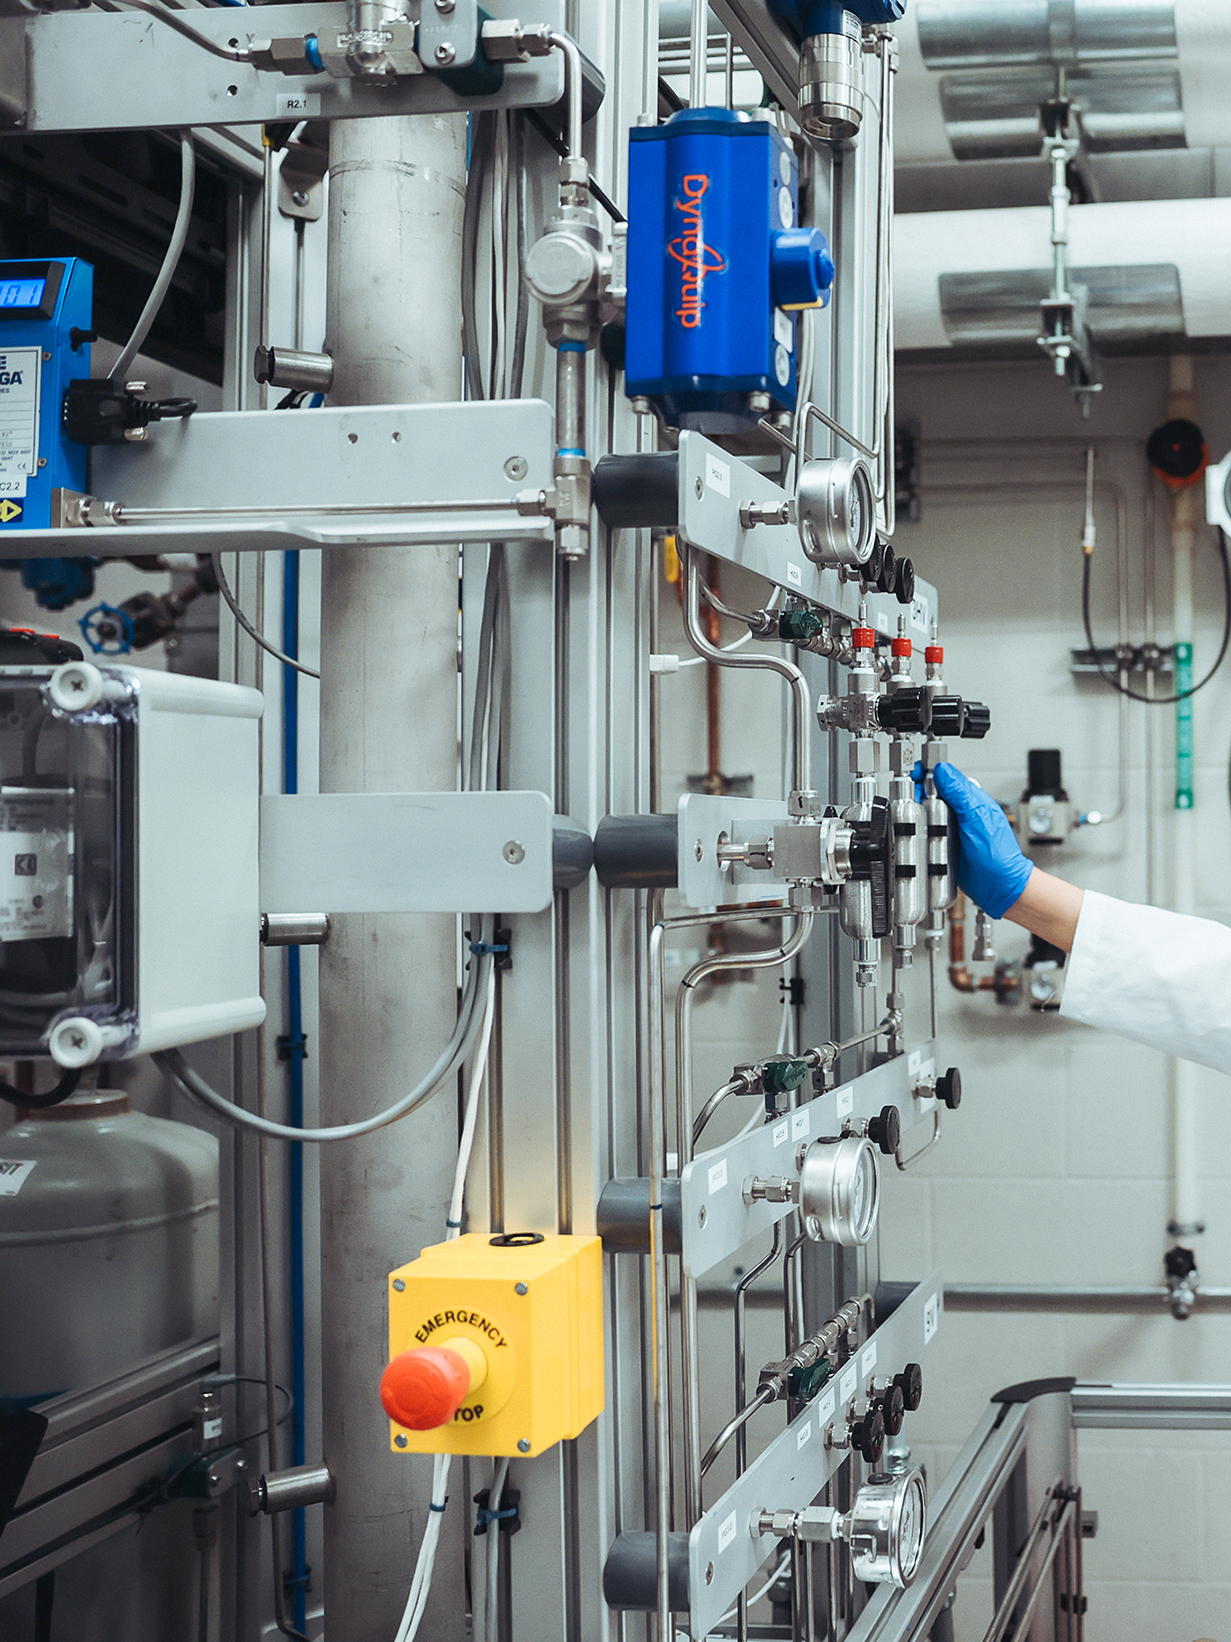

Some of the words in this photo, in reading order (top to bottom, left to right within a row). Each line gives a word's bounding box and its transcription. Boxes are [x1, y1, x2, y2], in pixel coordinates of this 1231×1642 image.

[287, 99, 307, 109] R2.1
[414, 1309, 508, 1349] EMERGENCY
[453, 1404, 485, 1422] TOP
